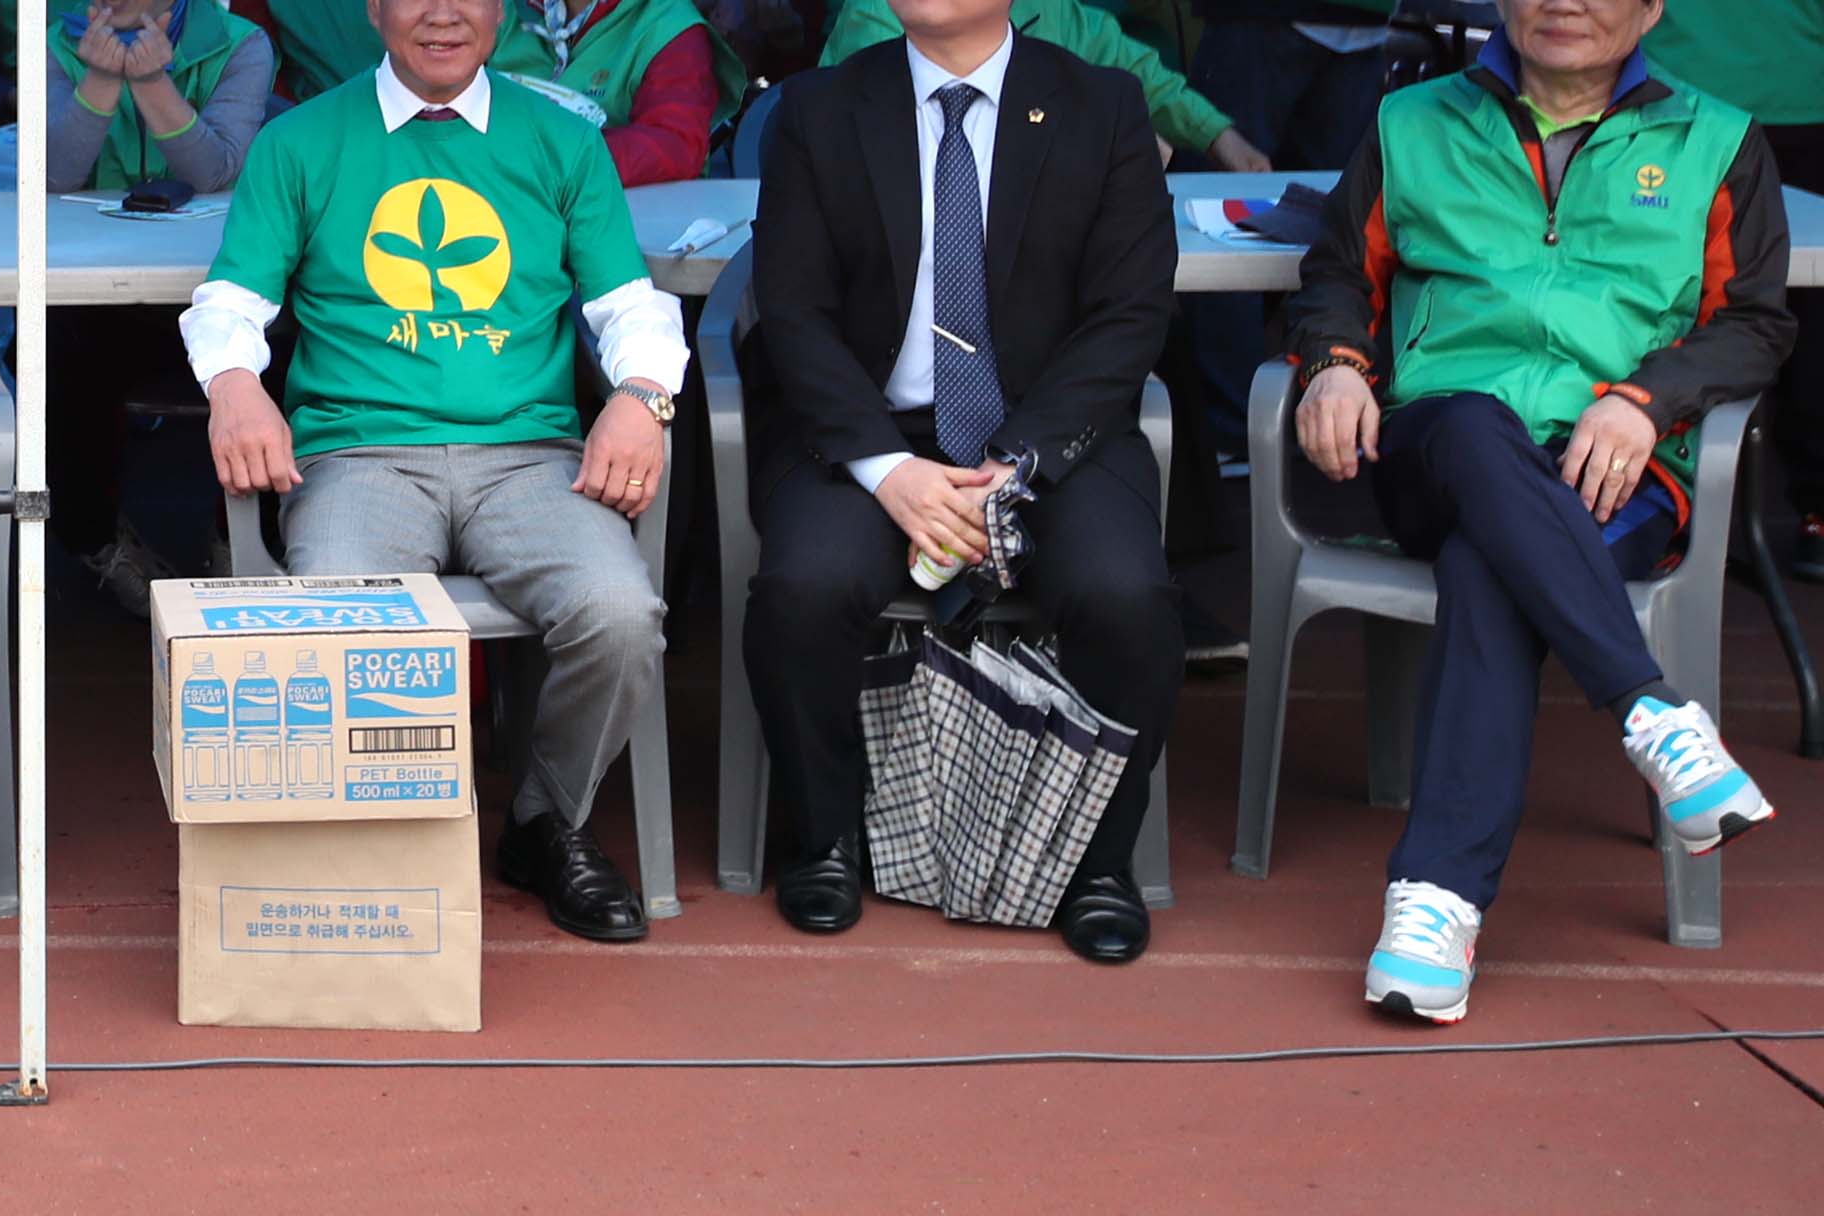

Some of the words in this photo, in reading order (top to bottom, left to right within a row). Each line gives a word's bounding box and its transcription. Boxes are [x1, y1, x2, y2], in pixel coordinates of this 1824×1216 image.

[347, 651, 453, 671] POCARI
[347, 669, 444, 689] SWEAT
[183, 686, 226, 697] POCARI
[359, 767, 390, 781] PET
[395, 767, 443, 780] Bottle
[260, 903, 331, 920] 운송하거나
